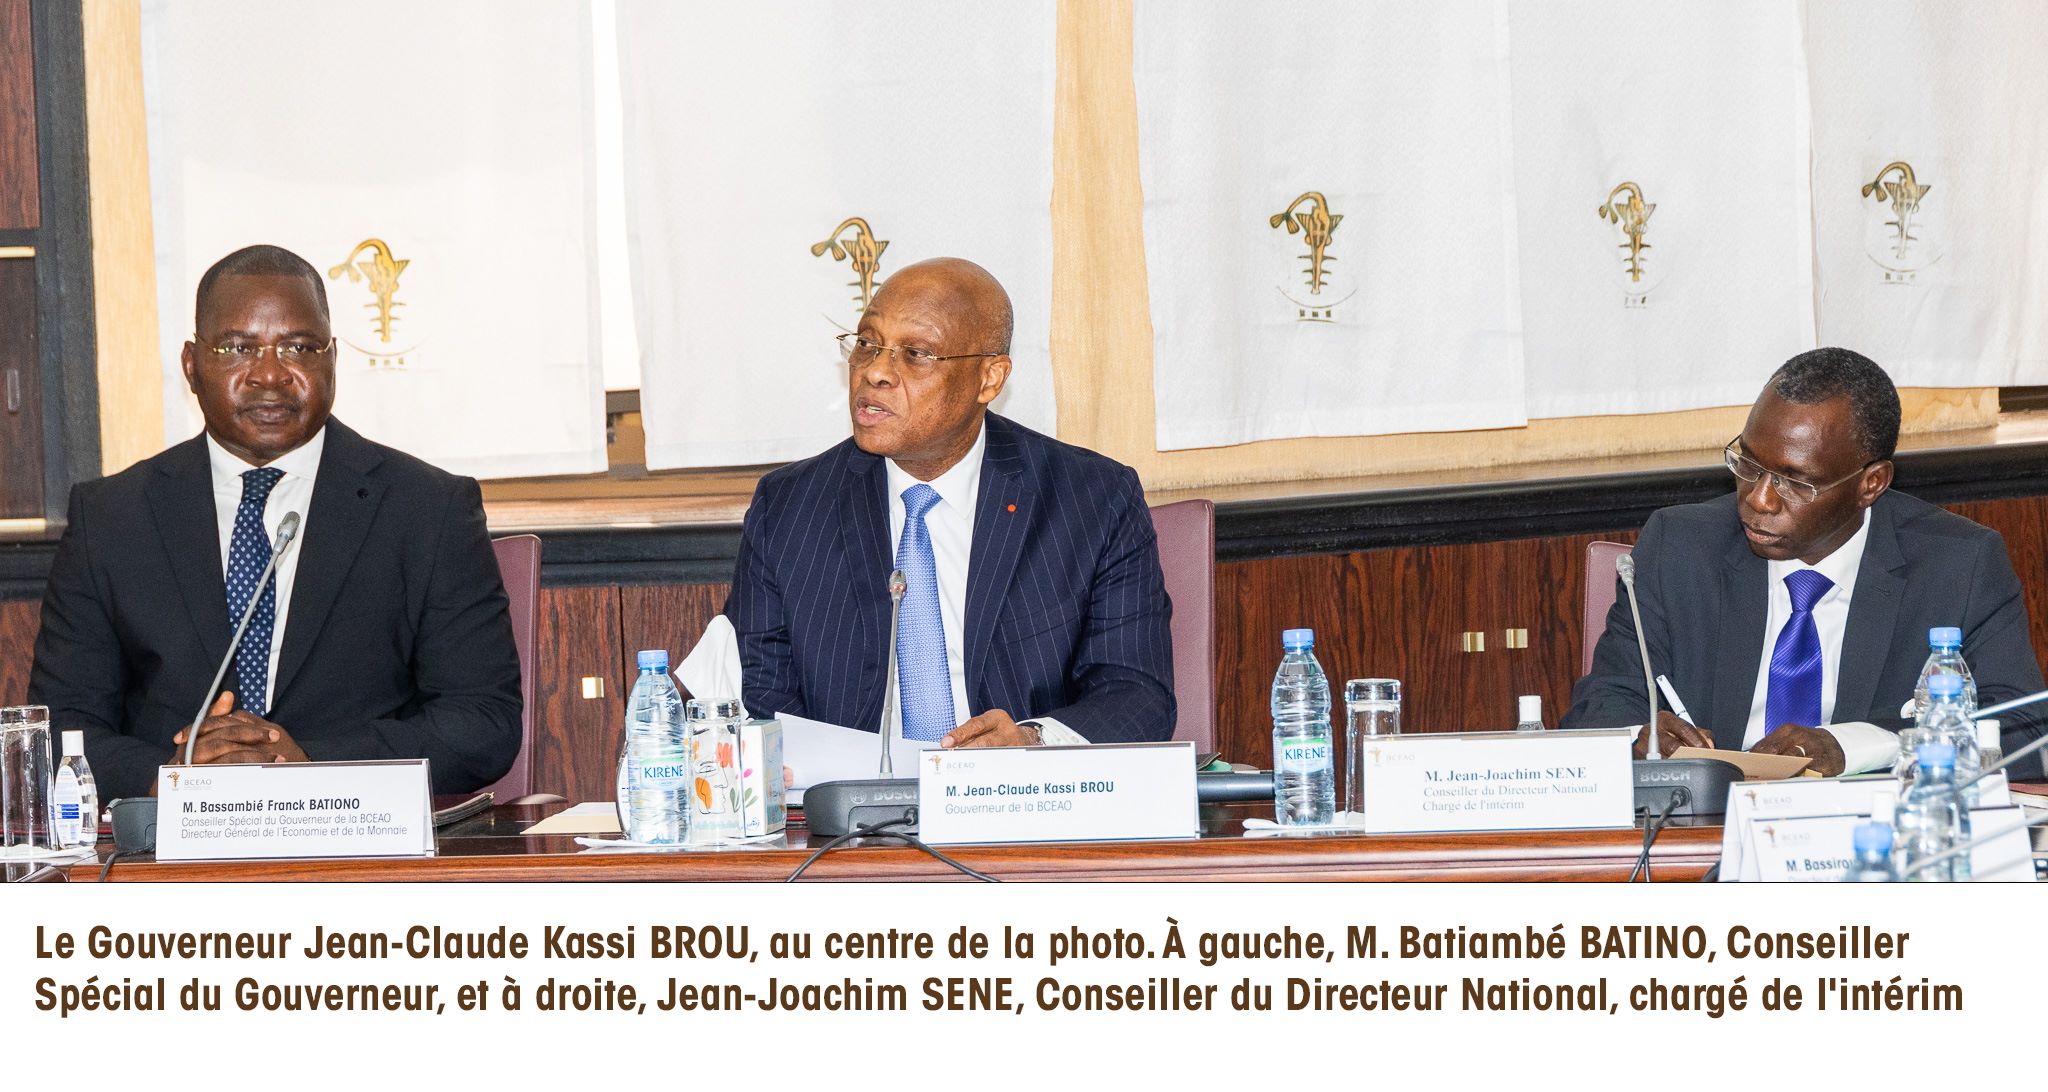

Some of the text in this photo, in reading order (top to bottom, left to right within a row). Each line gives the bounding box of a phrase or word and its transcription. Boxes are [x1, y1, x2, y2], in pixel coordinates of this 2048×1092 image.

[184, 778, 212, 786] BCEAO
[1425, 767, 1588, 783] M. Jean-Joachim SENE
[1640, 769, 1691, 782] BOSCH
[946, 780, 1114, 798] M. Jean-Claude Kassi BROU
[1423, 784, 1598, 797] Conseiller du Directeur National
[183, 798, 360, 813] M. Bassambié Franck BATIONO
[945, 801, 1072, 815] Gouverneur de la BCEAO
[1464, 800, 1477, 811] de
[182, 813, 391, 828] Conseiller Spécial du Gouverneur de la BCEAO
[181, 828, 222, 839] Directeur
[224, 826, 260, 839] Général
[262, 827, 274, 838] de
[330, 826, 339, 837] et
[341, 825, 353, 836] de
[356, 825, 365, 836] la
[367, 824, 407, 836] Monnaie
[1786, 859, 1802, 872] M.
